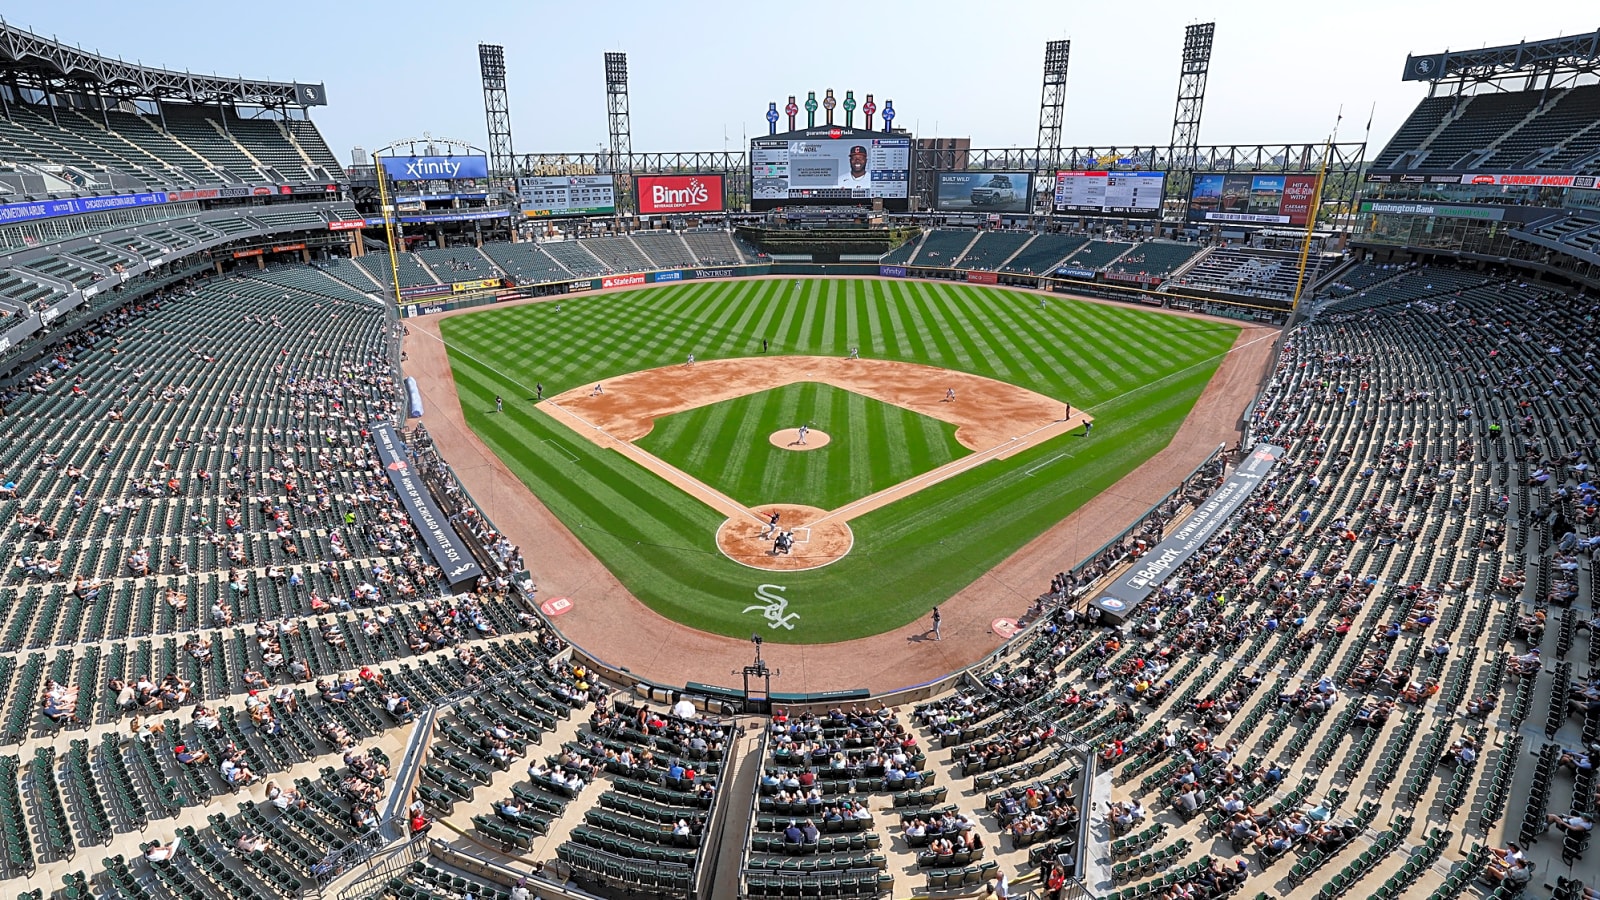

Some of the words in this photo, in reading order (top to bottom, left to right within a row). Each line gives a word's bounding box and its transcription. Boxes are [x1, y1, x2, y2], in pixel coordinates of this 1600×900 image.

[406, 159, 460, 178] xfinity
[1500, 176, 1541, 184] CURRENT
[1541, 176, 1573, 185] AMOUNT
[1372, 203, 1416, 213] Huntington
[1416, 205, 1434, 213] Bank
[424, 306, 442, 315] Modelo
[402, 476, 415, 491] HOME
[412, 496, 425, 507] THE
[418, 506, 439, 530] CHICAGO
[1175, 510, 1210, 540] DOWNLOAD
[1206, 501, 1219, 513] AND
[1214, 482, 1239, 502] CHECK-IN
[433, 529, 451, 548] WHITE
[444, 548, 461, 562] SOX
[1137, 548, 1183, 580] Ballpark
